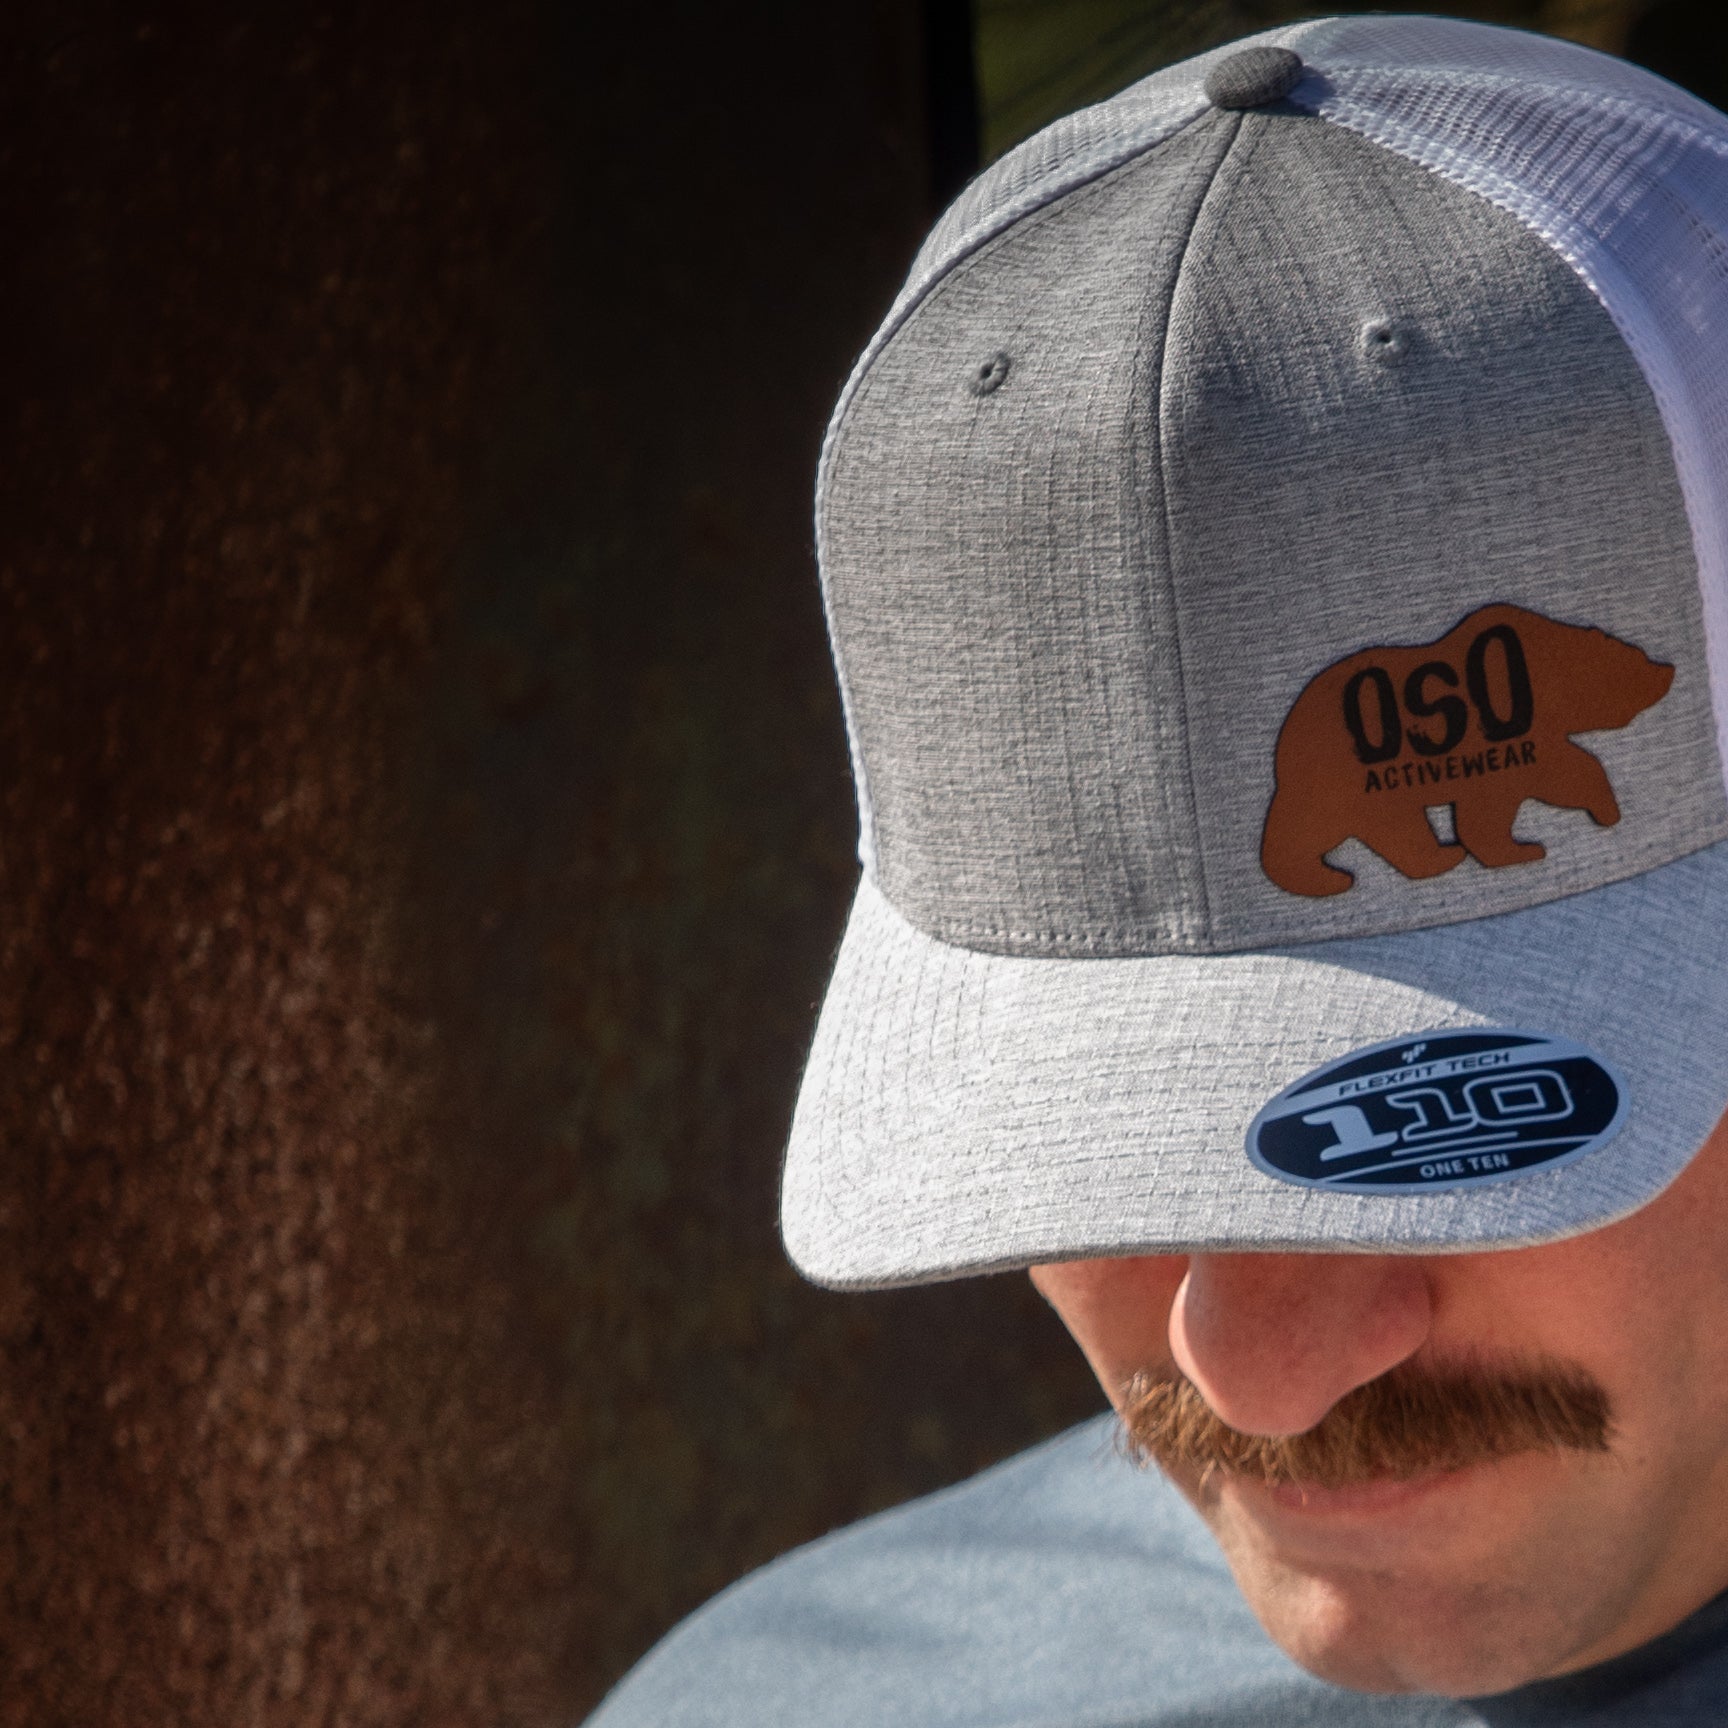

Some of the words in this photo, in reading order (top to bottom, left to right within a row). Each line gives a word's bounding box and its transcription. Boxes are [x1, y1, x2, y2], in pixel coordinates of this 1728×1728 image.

[1344, 625, 1533, 764] OSO
[1365, 742, 1536, 793] ACTIVEWEAR
[1339, 1066, 1436, 1095] FLEXFIT
[1445, 1051, 1511, 1073] TECH
[1302, 1069, 1575, 1162] 110
[1419, 1161, 1465, 1180] ONE
[1466, 1153, 1510, 1171] TEN
